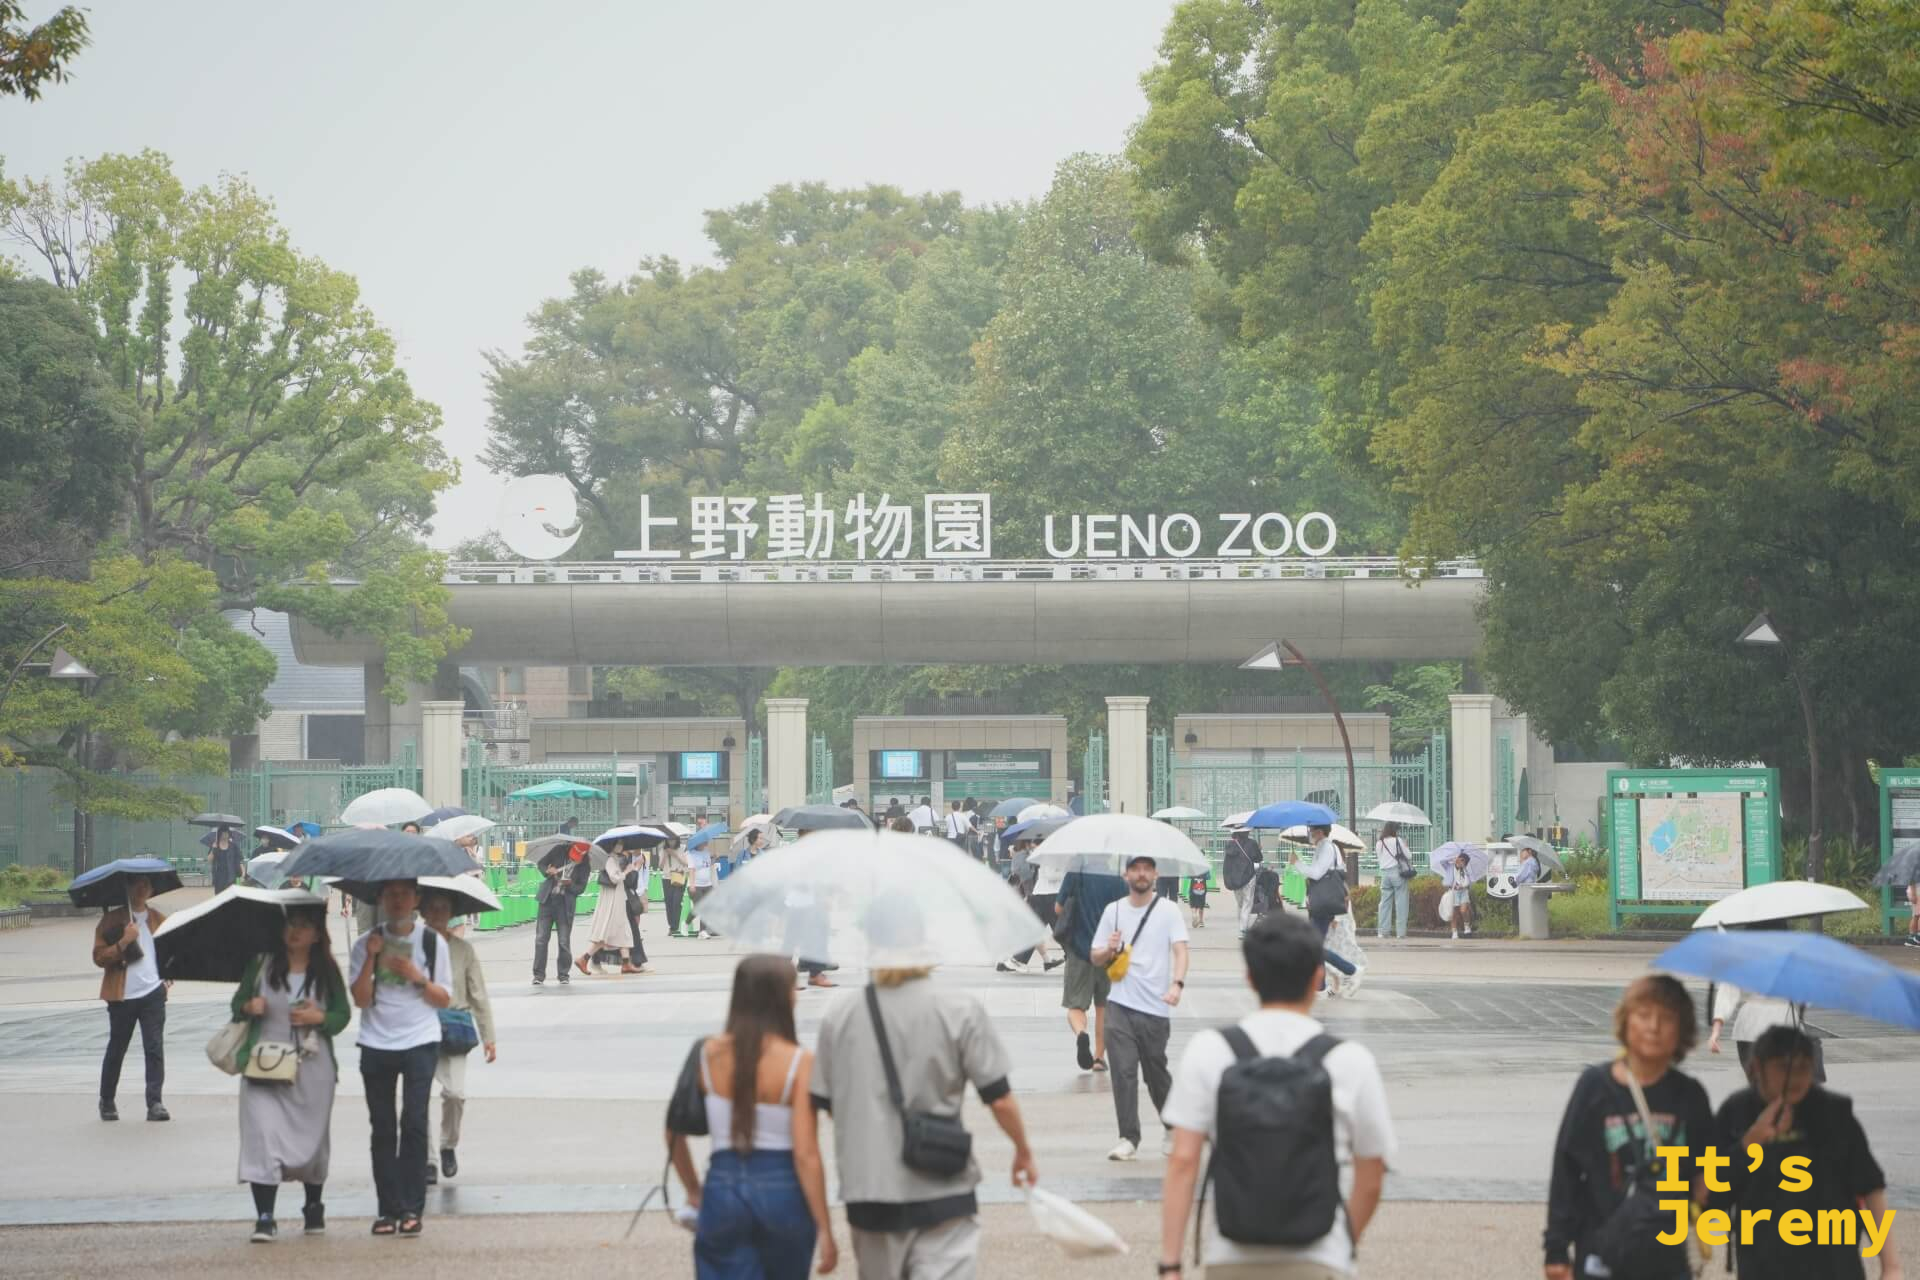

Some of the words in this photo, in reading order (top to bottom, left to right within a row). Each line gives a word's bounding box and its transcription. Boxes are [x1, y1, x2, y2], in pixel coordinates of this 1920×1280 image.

[613, 492, 991, 560] 上野動物園
[1044, 512, 1201, 558] UENO
[1217, 511, 1337, 557] ZOO
